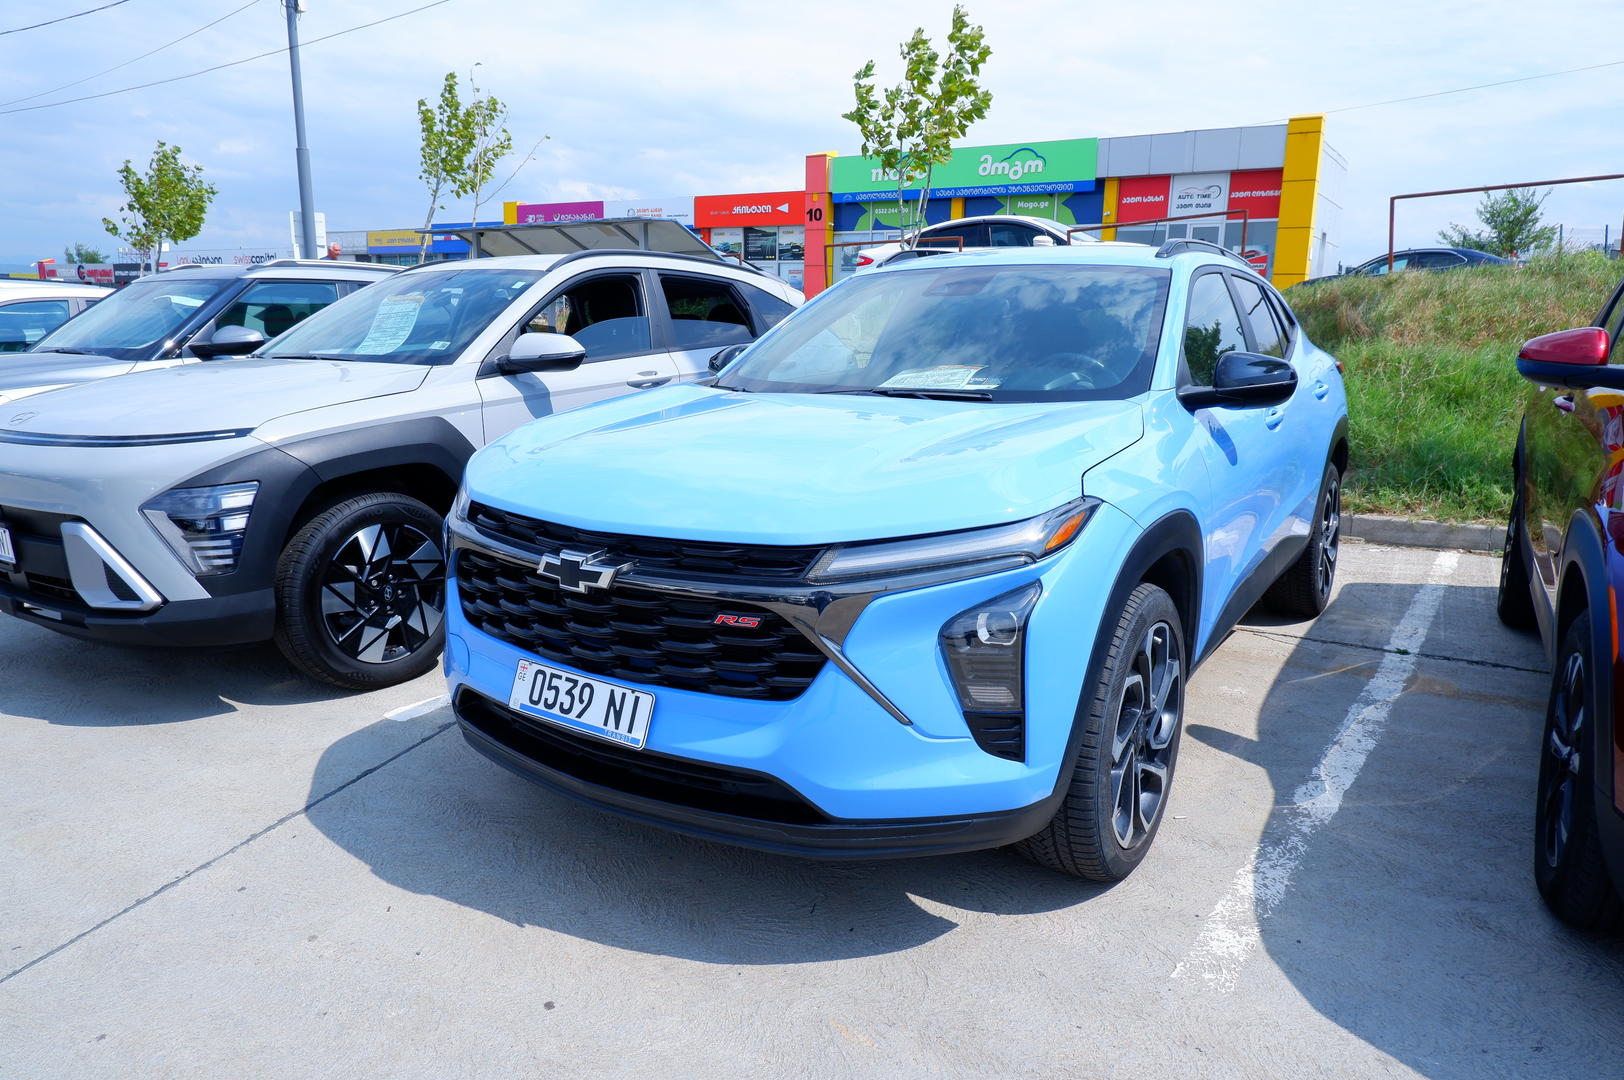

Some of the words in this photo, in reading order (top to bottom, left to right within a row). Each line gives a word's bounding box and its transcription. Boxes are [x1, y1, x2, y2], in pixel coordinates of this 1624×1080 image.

[978, 154, 1044, 180] მოგო
[855, 191, 901, 201] ავტოლიზინგ
[731, 204, 773, 215] კრისტალი
[1017, 200, 1049, 210] Mogo.ge
[806, 207, 823, 221] 10
[714, 614, 761, 627] RS
[518, 671, 527, 682] GE
[528, 669, 595, 719] 0539
[603, 689, 641, 734] NI
